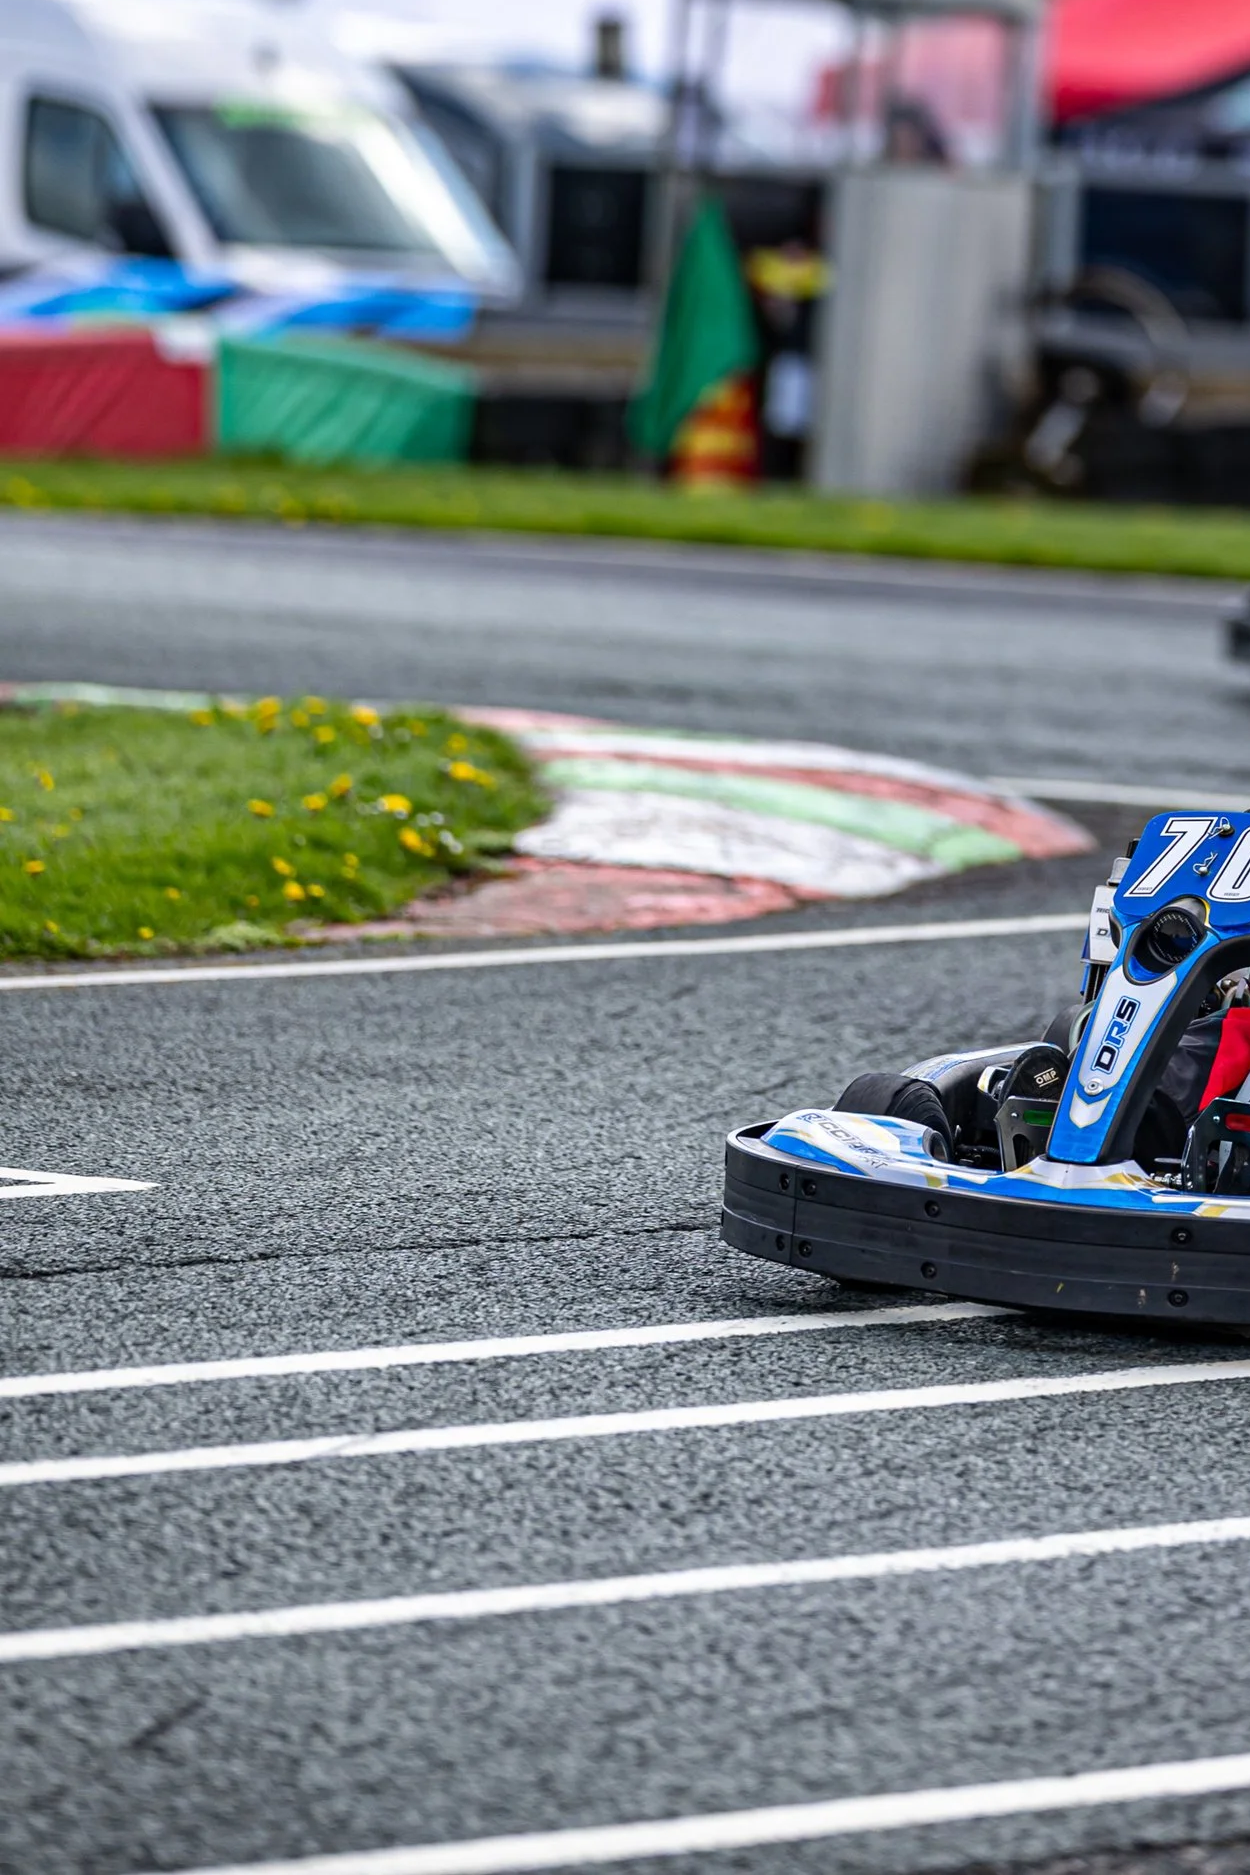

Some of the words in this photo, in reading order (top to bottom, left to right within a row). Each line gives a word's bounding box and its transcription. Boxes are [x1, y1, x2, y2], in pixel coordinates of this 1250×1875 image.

[1092, 996, 1141, 1074] DRS
[1035, 1069, 1057, 1085] OMP
[797, 1112, 892, 1162] RICCIAR
